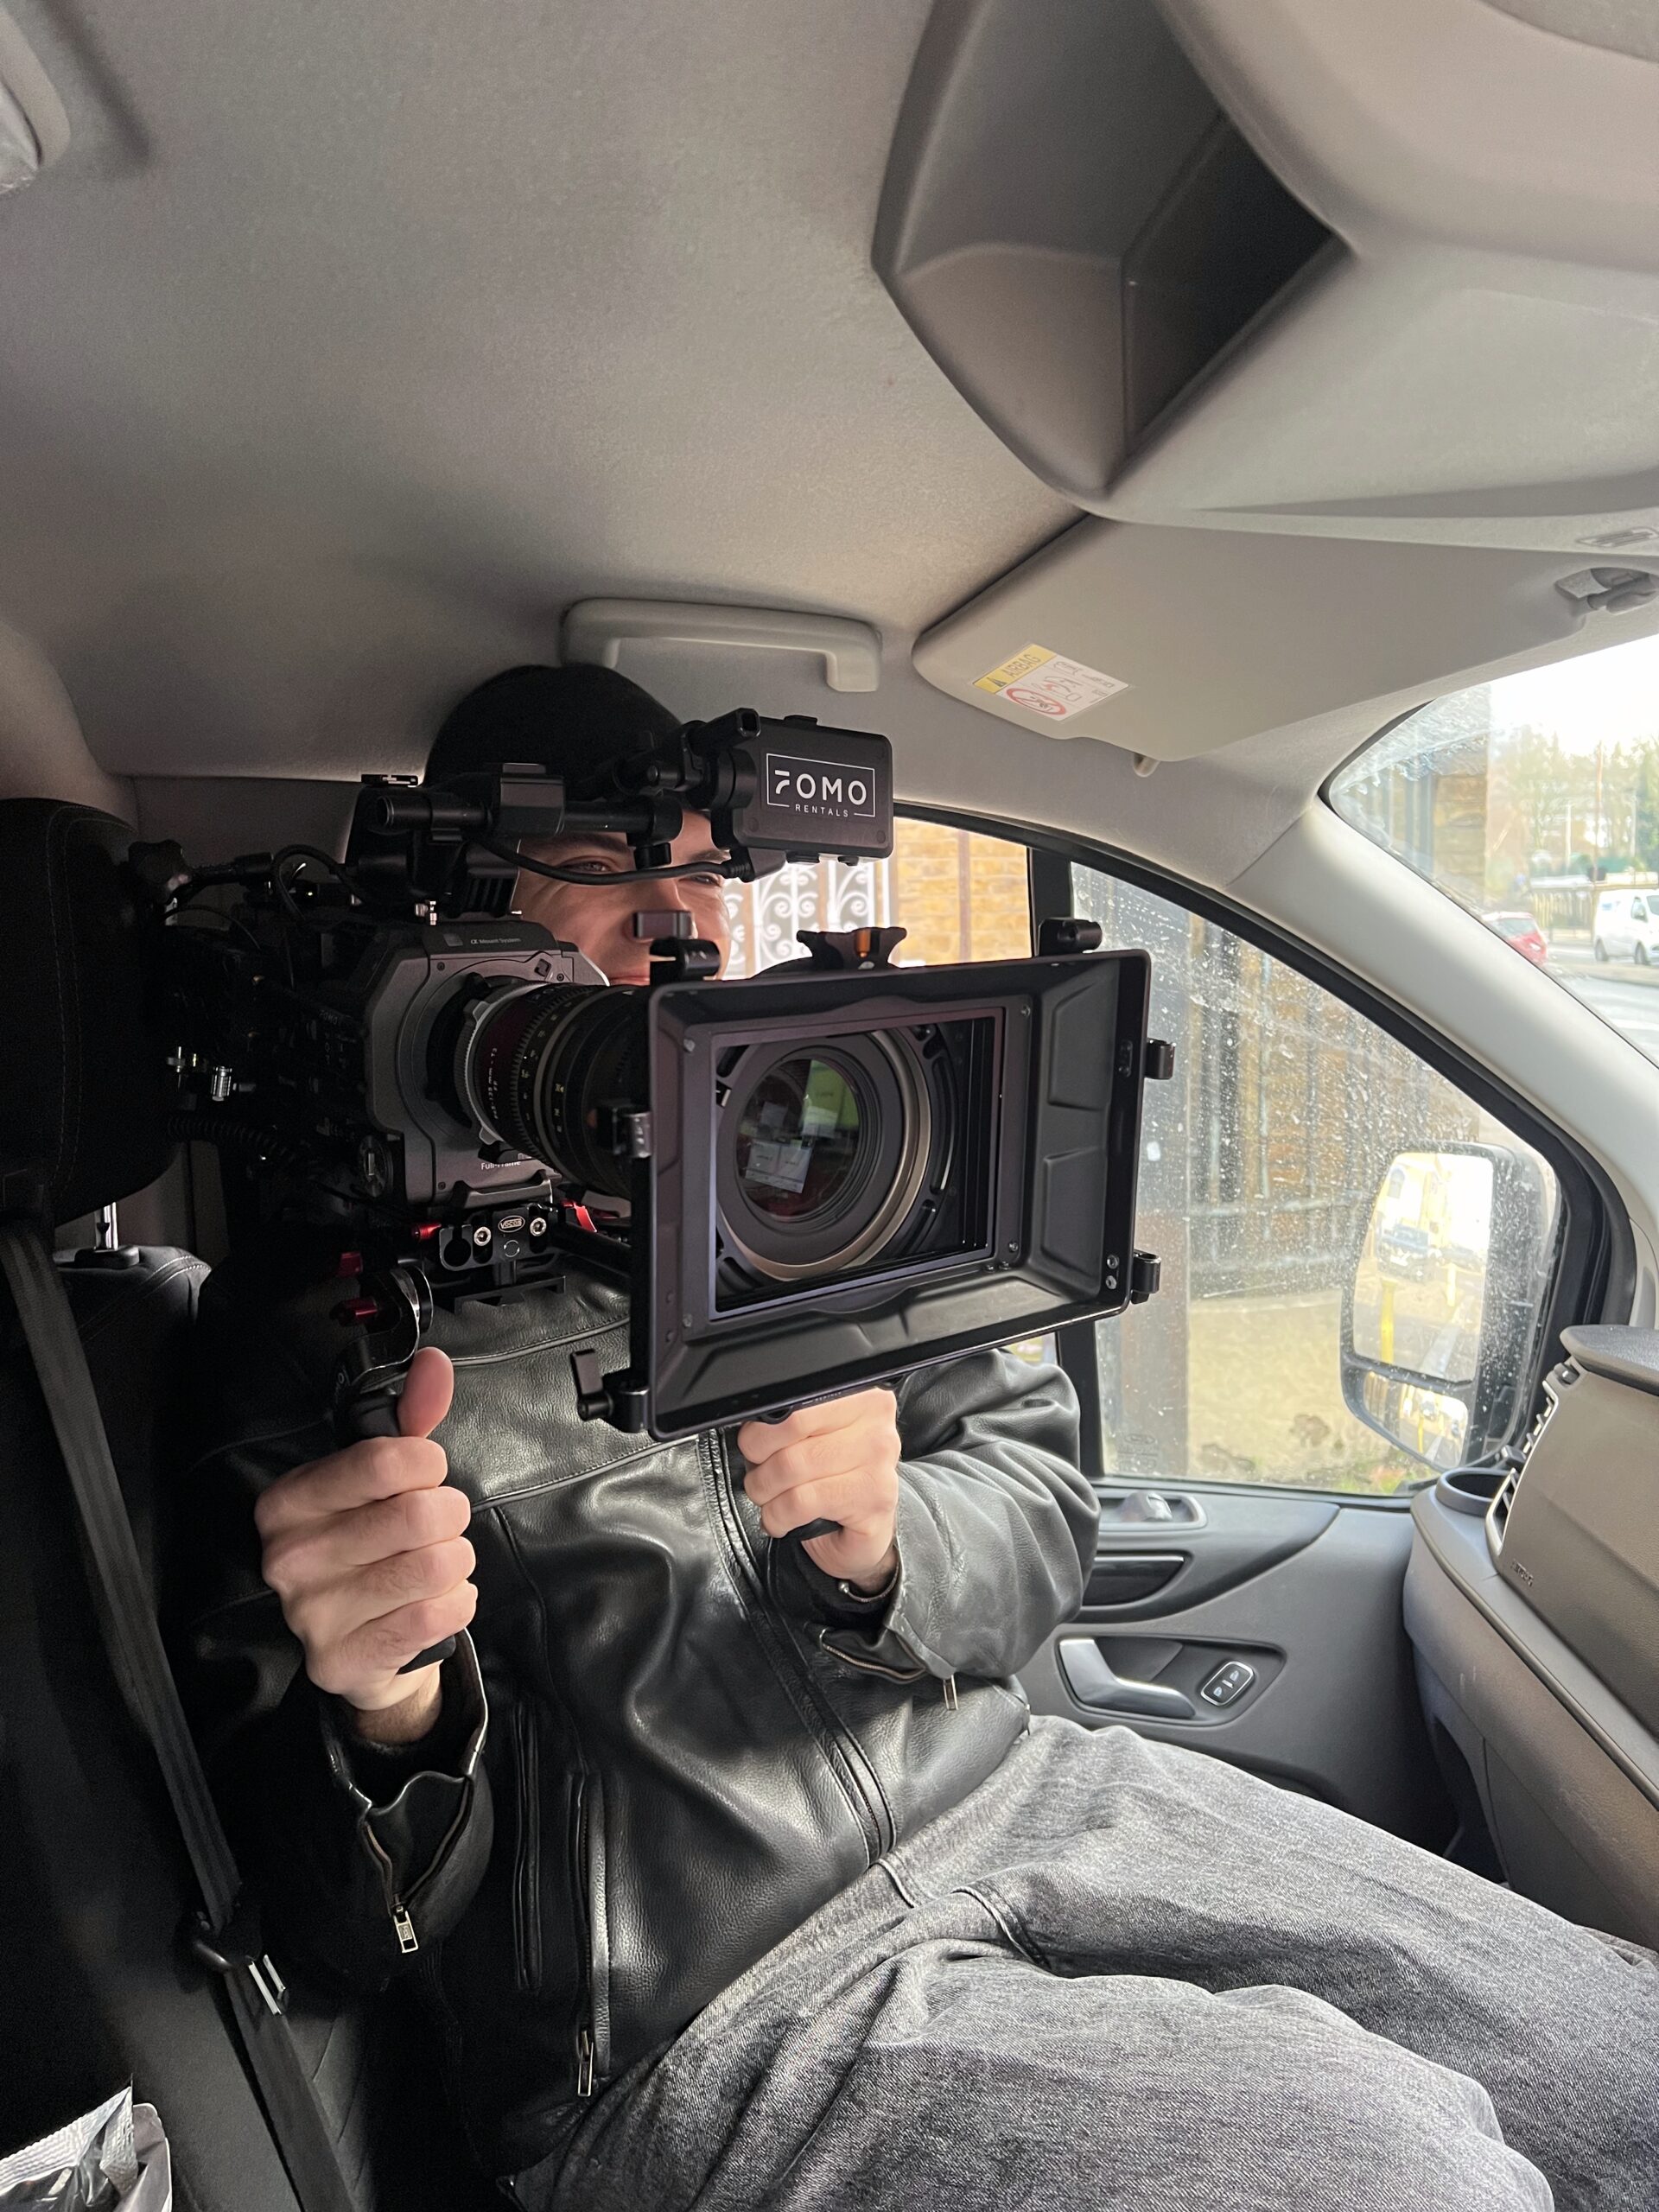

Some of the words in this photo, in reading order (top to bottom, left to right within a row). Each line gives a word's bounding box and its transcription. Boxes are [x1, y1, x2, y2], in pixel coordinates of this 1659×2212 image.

[1001, 654, 1041, 677] AIRBAG
[774, 769, 867, 805] FOMO
[795, 804, 849, 817] RENTALS
